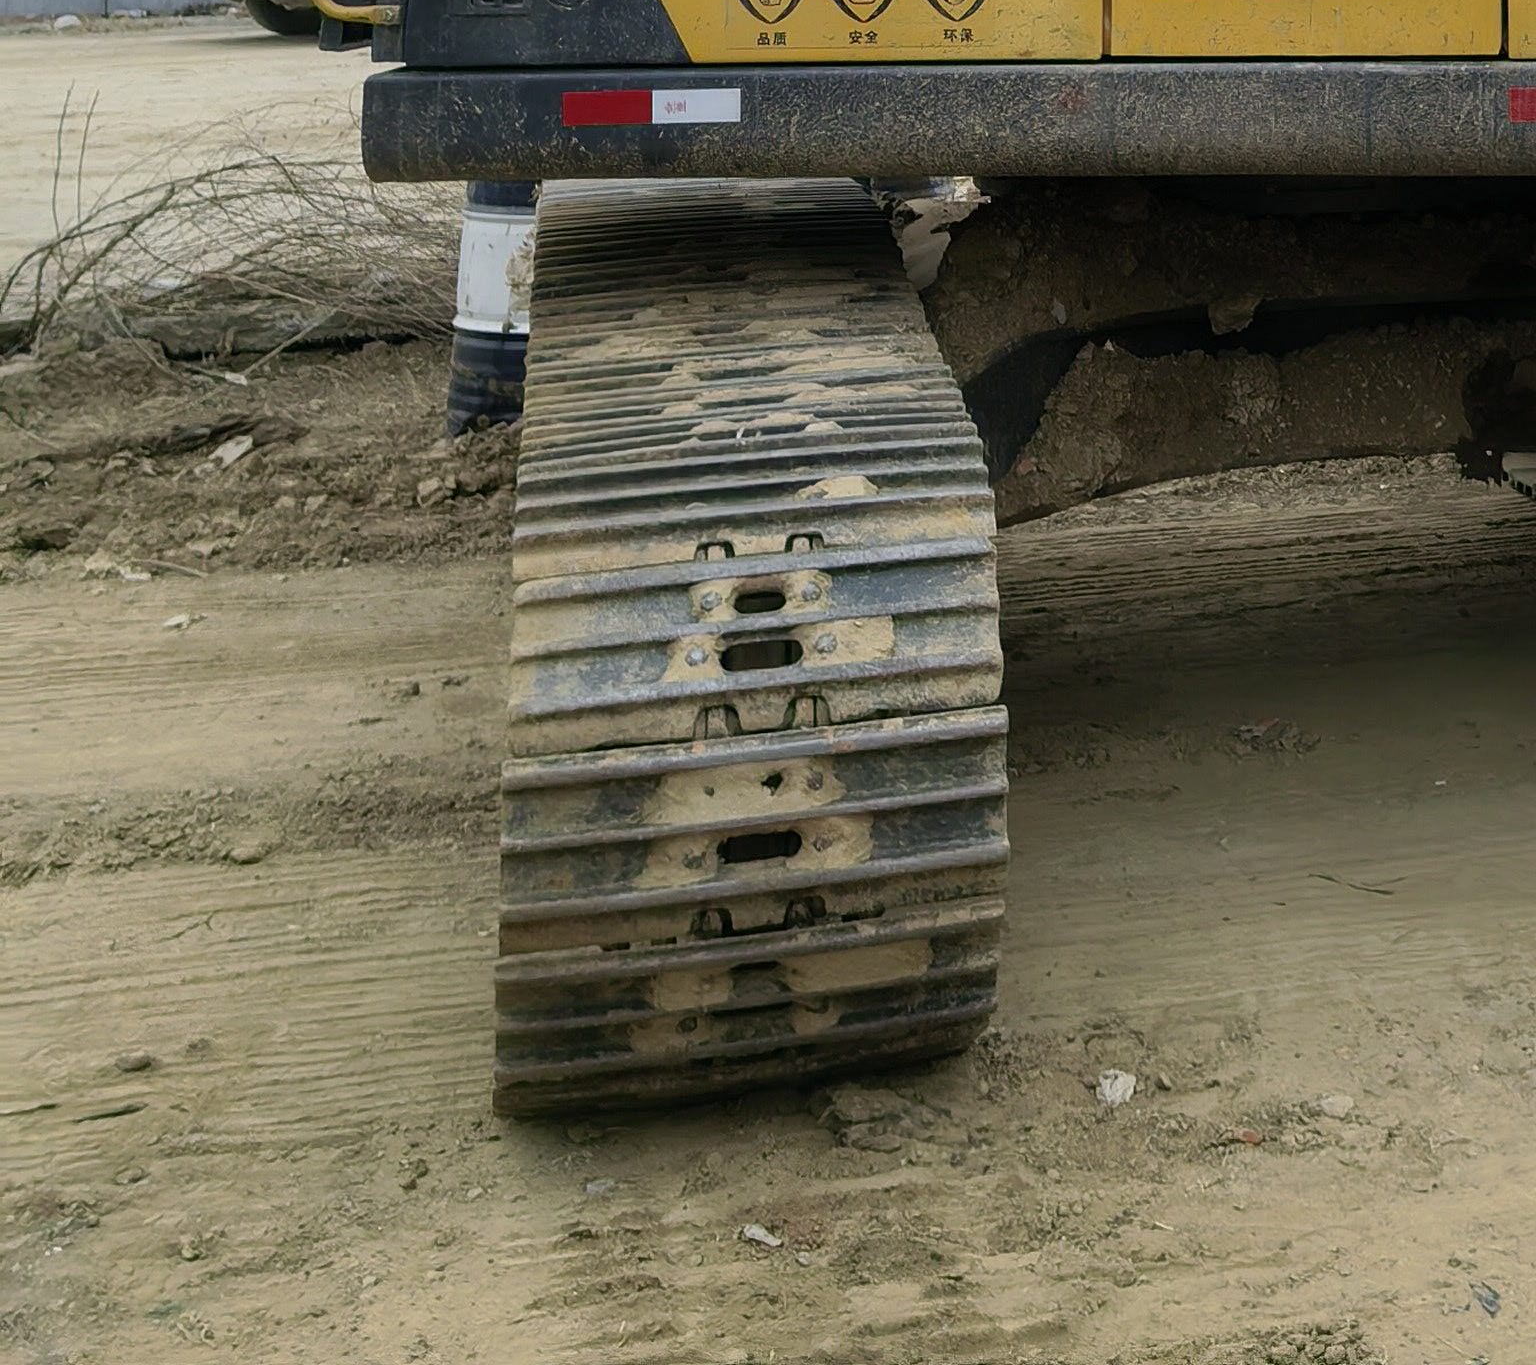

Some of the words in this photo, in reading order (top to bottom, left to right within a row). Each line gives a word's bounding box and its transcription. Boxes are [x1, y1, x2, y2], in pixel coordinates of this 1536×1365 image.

[757, 31, 788, 46] 品质
[849, 30, 879, 45] 安全
[943, 28, 975, 43] 环保
